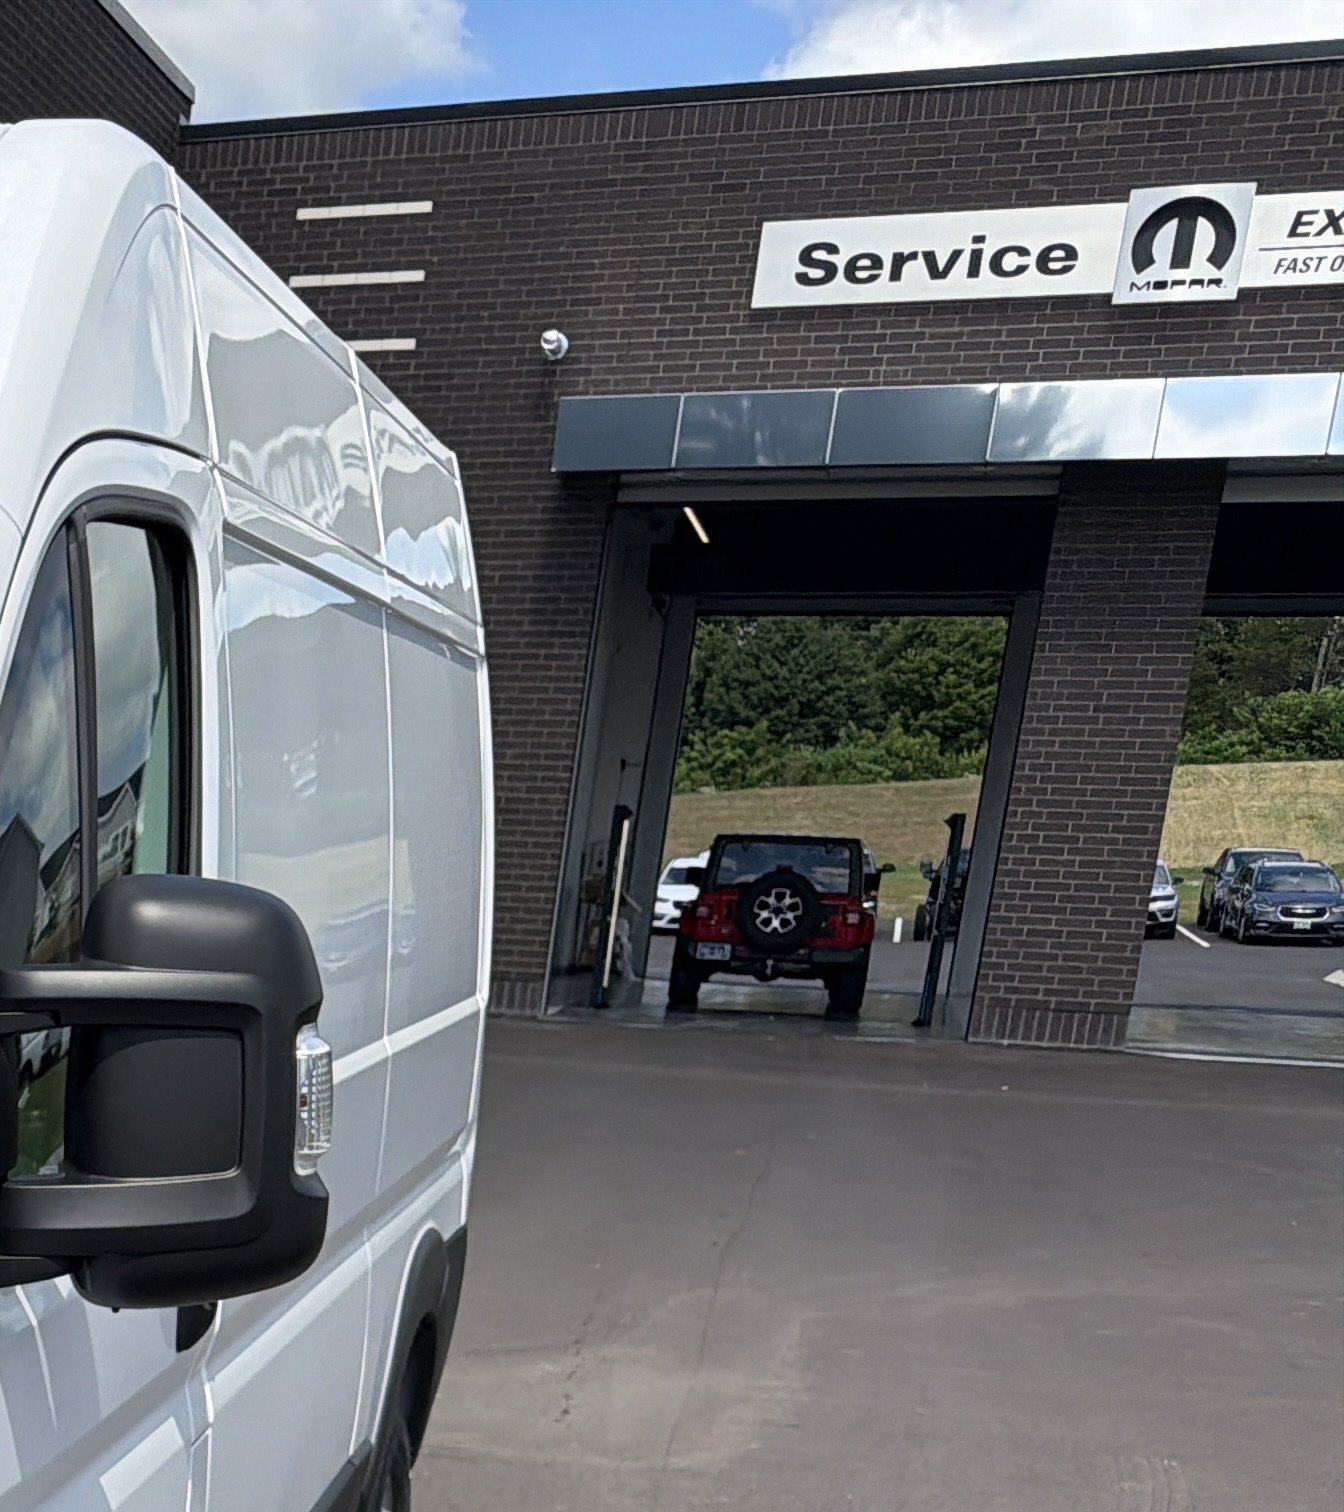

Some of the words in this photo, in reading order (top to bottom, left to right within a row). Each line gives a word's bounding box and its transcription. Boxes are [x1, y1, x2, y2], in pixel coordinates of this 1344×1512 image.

[794, 234, 1080, 287] Service
[1273, 256, 1328, 275] FAST
[1129, 278, 1223, 292] MOPAR
